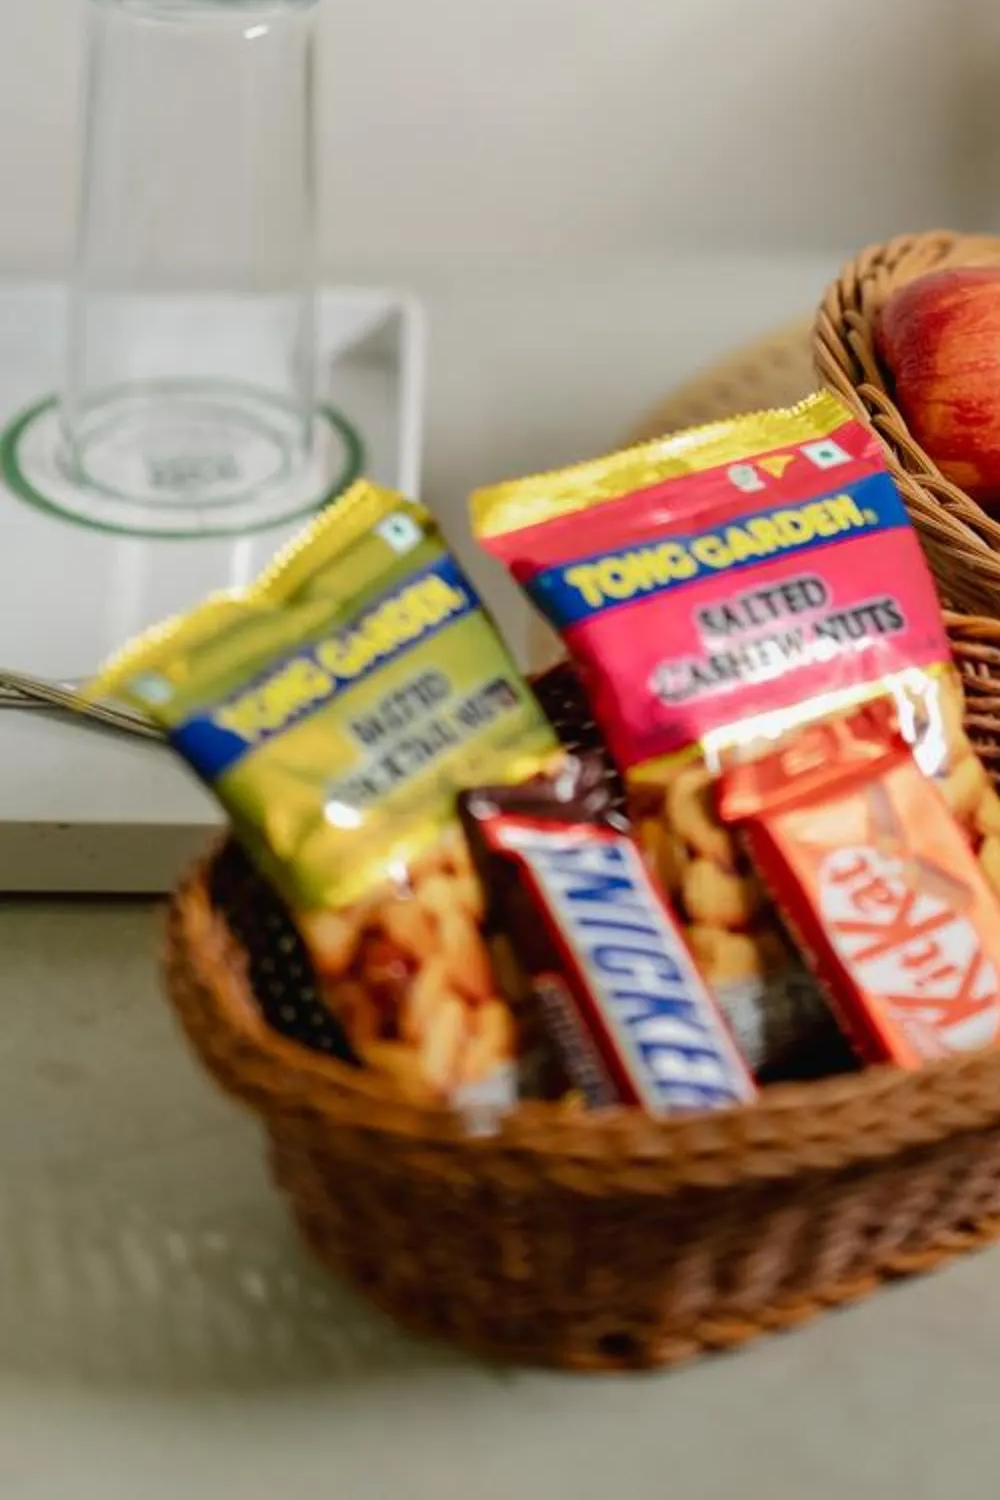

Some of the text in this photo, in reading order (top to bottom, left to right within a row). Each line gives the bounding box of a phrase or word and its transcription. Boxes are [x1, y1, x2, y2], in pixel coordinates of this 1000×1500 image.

[565, 541, 697, 604] TONG
[697, 576, 828, 636] SALTED
[808, 598, 905, 652] NUTS
